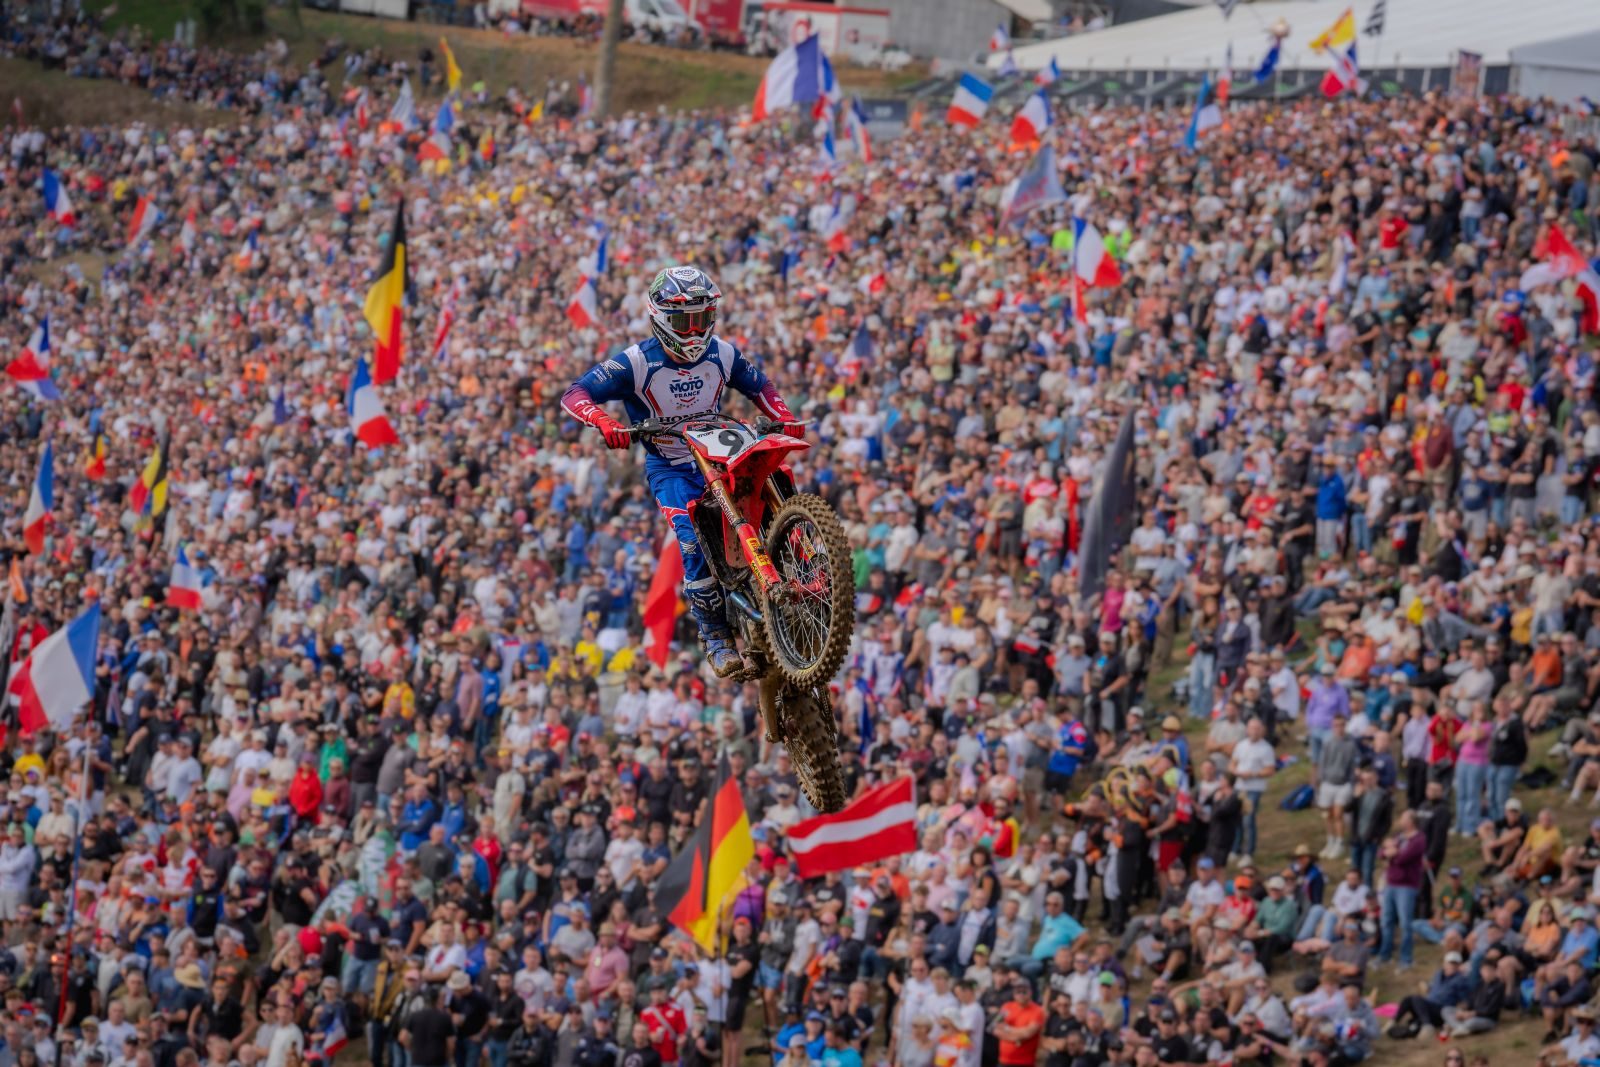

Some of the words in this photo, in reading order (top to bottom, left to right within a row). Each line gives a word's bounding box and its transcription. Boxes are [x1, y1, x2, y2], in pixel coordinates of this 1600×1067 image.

[669, 380, 704, 393] MOTO
[674, 390, 701, 398] FRANCE
[658, 409, 718, 423] HOA
[718, 430, 745, 457] 9
